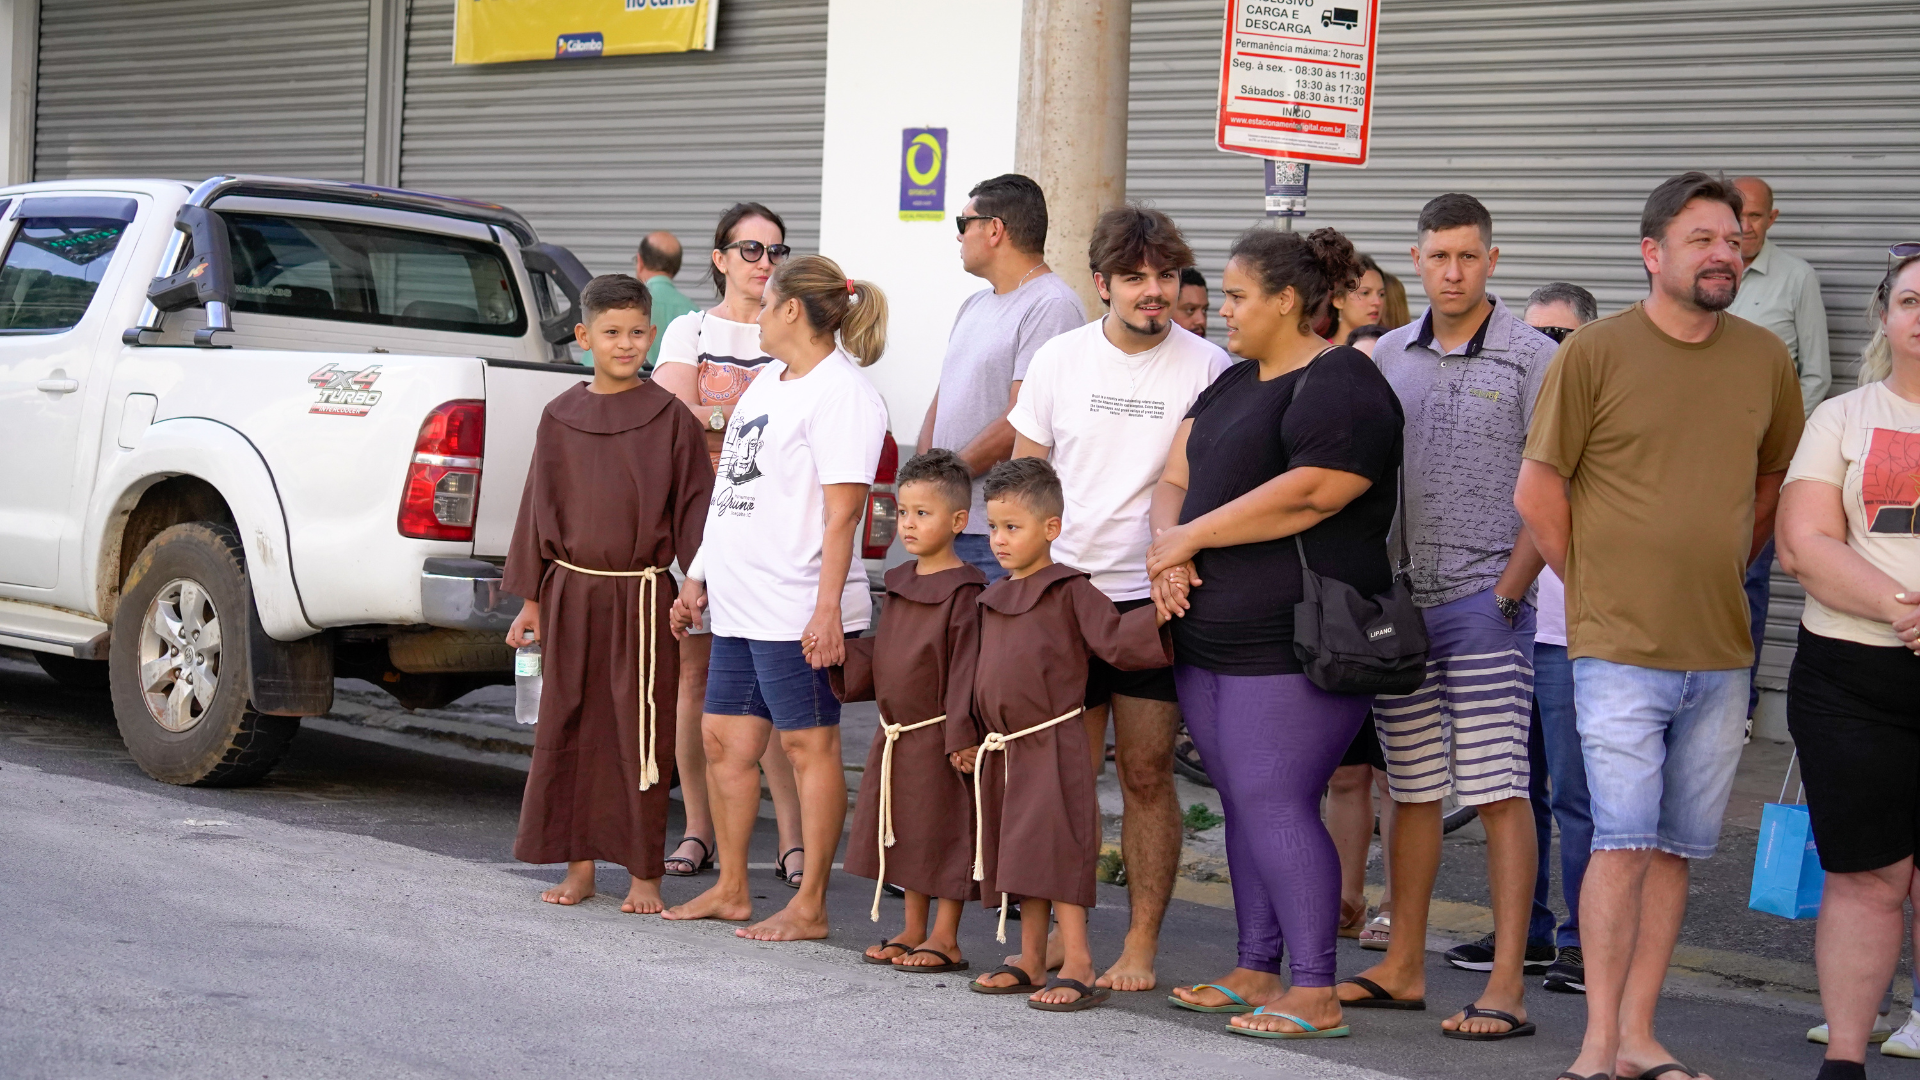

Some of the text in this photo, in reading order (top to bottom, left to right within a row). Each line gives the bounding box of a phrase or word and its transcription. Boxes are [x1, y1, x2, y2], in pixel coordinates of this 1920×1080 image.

[1246, 4, 1300, 19] CARGA E
[1245, 18, 1312, 35] DESCARGA
[567, 38, 603, 52] Colombo
[1235, 38, 1364, 61] Permanência máxima: 2 horas
[1232, 58, 1254, 71] Seg.
[1257, 61, 1264, 70] à
[1266, 63, 1286, 73] sex.
[1295, 65, 1323, 77] 08:30
[1325, 68, 1337, 78] às
[1339, 70, 1366, 82] 11:30
[1240, 84, 1285, 98] Sábados
[1293, 90, 1321, 102] 08:30
[1323, 93, 1335, 103] às
[1337, 95, 1365, 106] 11:30
[1295, 79, 1366, 95] 13:30 às 17:30
[1230, 116, 1342, 134] www.estacionamentigital.com.br
[316, 388, 383, 406] TURBO
[1370, 626, 1393, 638] LIPANO
